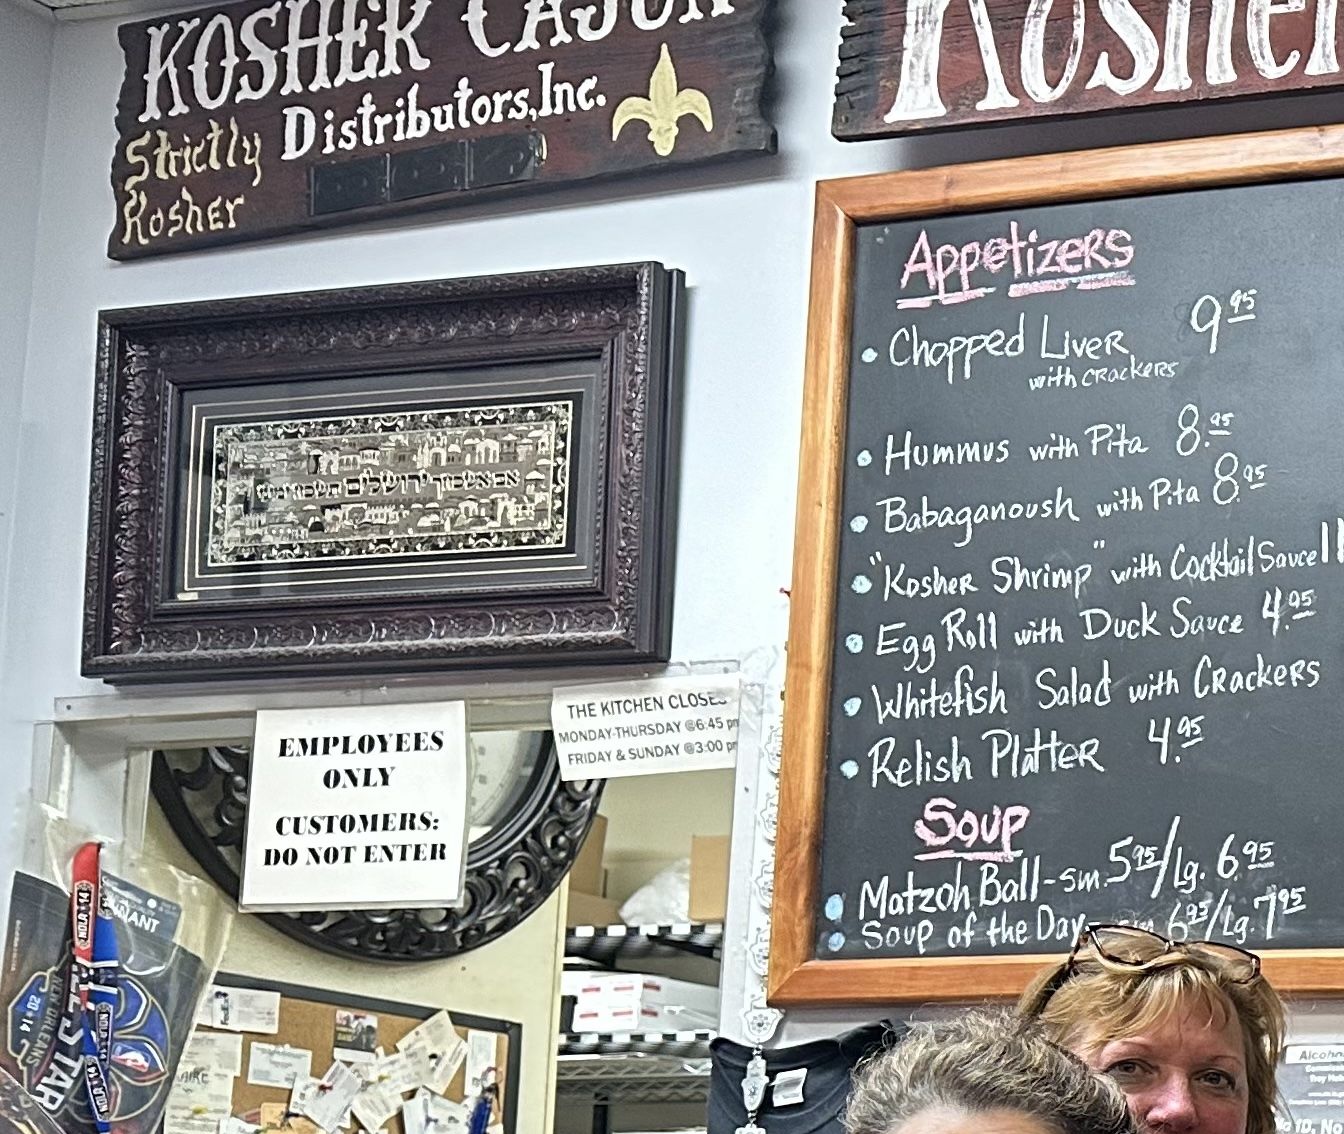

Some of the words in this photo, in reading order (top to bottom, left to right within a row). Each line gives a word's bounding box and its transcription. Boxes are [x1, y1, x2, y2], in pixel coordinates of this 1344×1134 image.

[138, 0, 430, 123] KOSHER
[125, 119, 264, 191] Strictly
[122, 191, 245, 247] Kosher
[889, 313, 1025, 383] Chopped
[885, 431, 1010, 476] Hummus
[1085, 424, 1148, 458] Pita
[876, 488, 1079, 548] Babaganoush
[1171, 535, 1257, 584] Cocktail
[875, 623, 935, 673] Egg
[942, 608, 997, 651] Roll
[1079, 604, 1160, 642] Duck
[1171, 598, 1244, 638] Sauce
[567, 703, 598, 720] THE
[602, 697, 665, 716] KITCHEN
[872, 666, 1008, 724] Whitefish
[1037, 660, 1112, 710] Salad
[277, 730, 444, 759] EMPLOYEES
[567, 748, 612, 766] FRIDAY
[628, 743, 680, 762] SUNDAY
[869, 737, 973, 788] Relish
[322, 766, 396, 790] ONLY
[275, 811, 439, 836] CUSTOMERS:
[915, 797, 1029, 849] Soup
[264, 847, 298, 867] DO
[306, 846, 357, 865] NOT
[364, 843, 446, 863] ENTER
